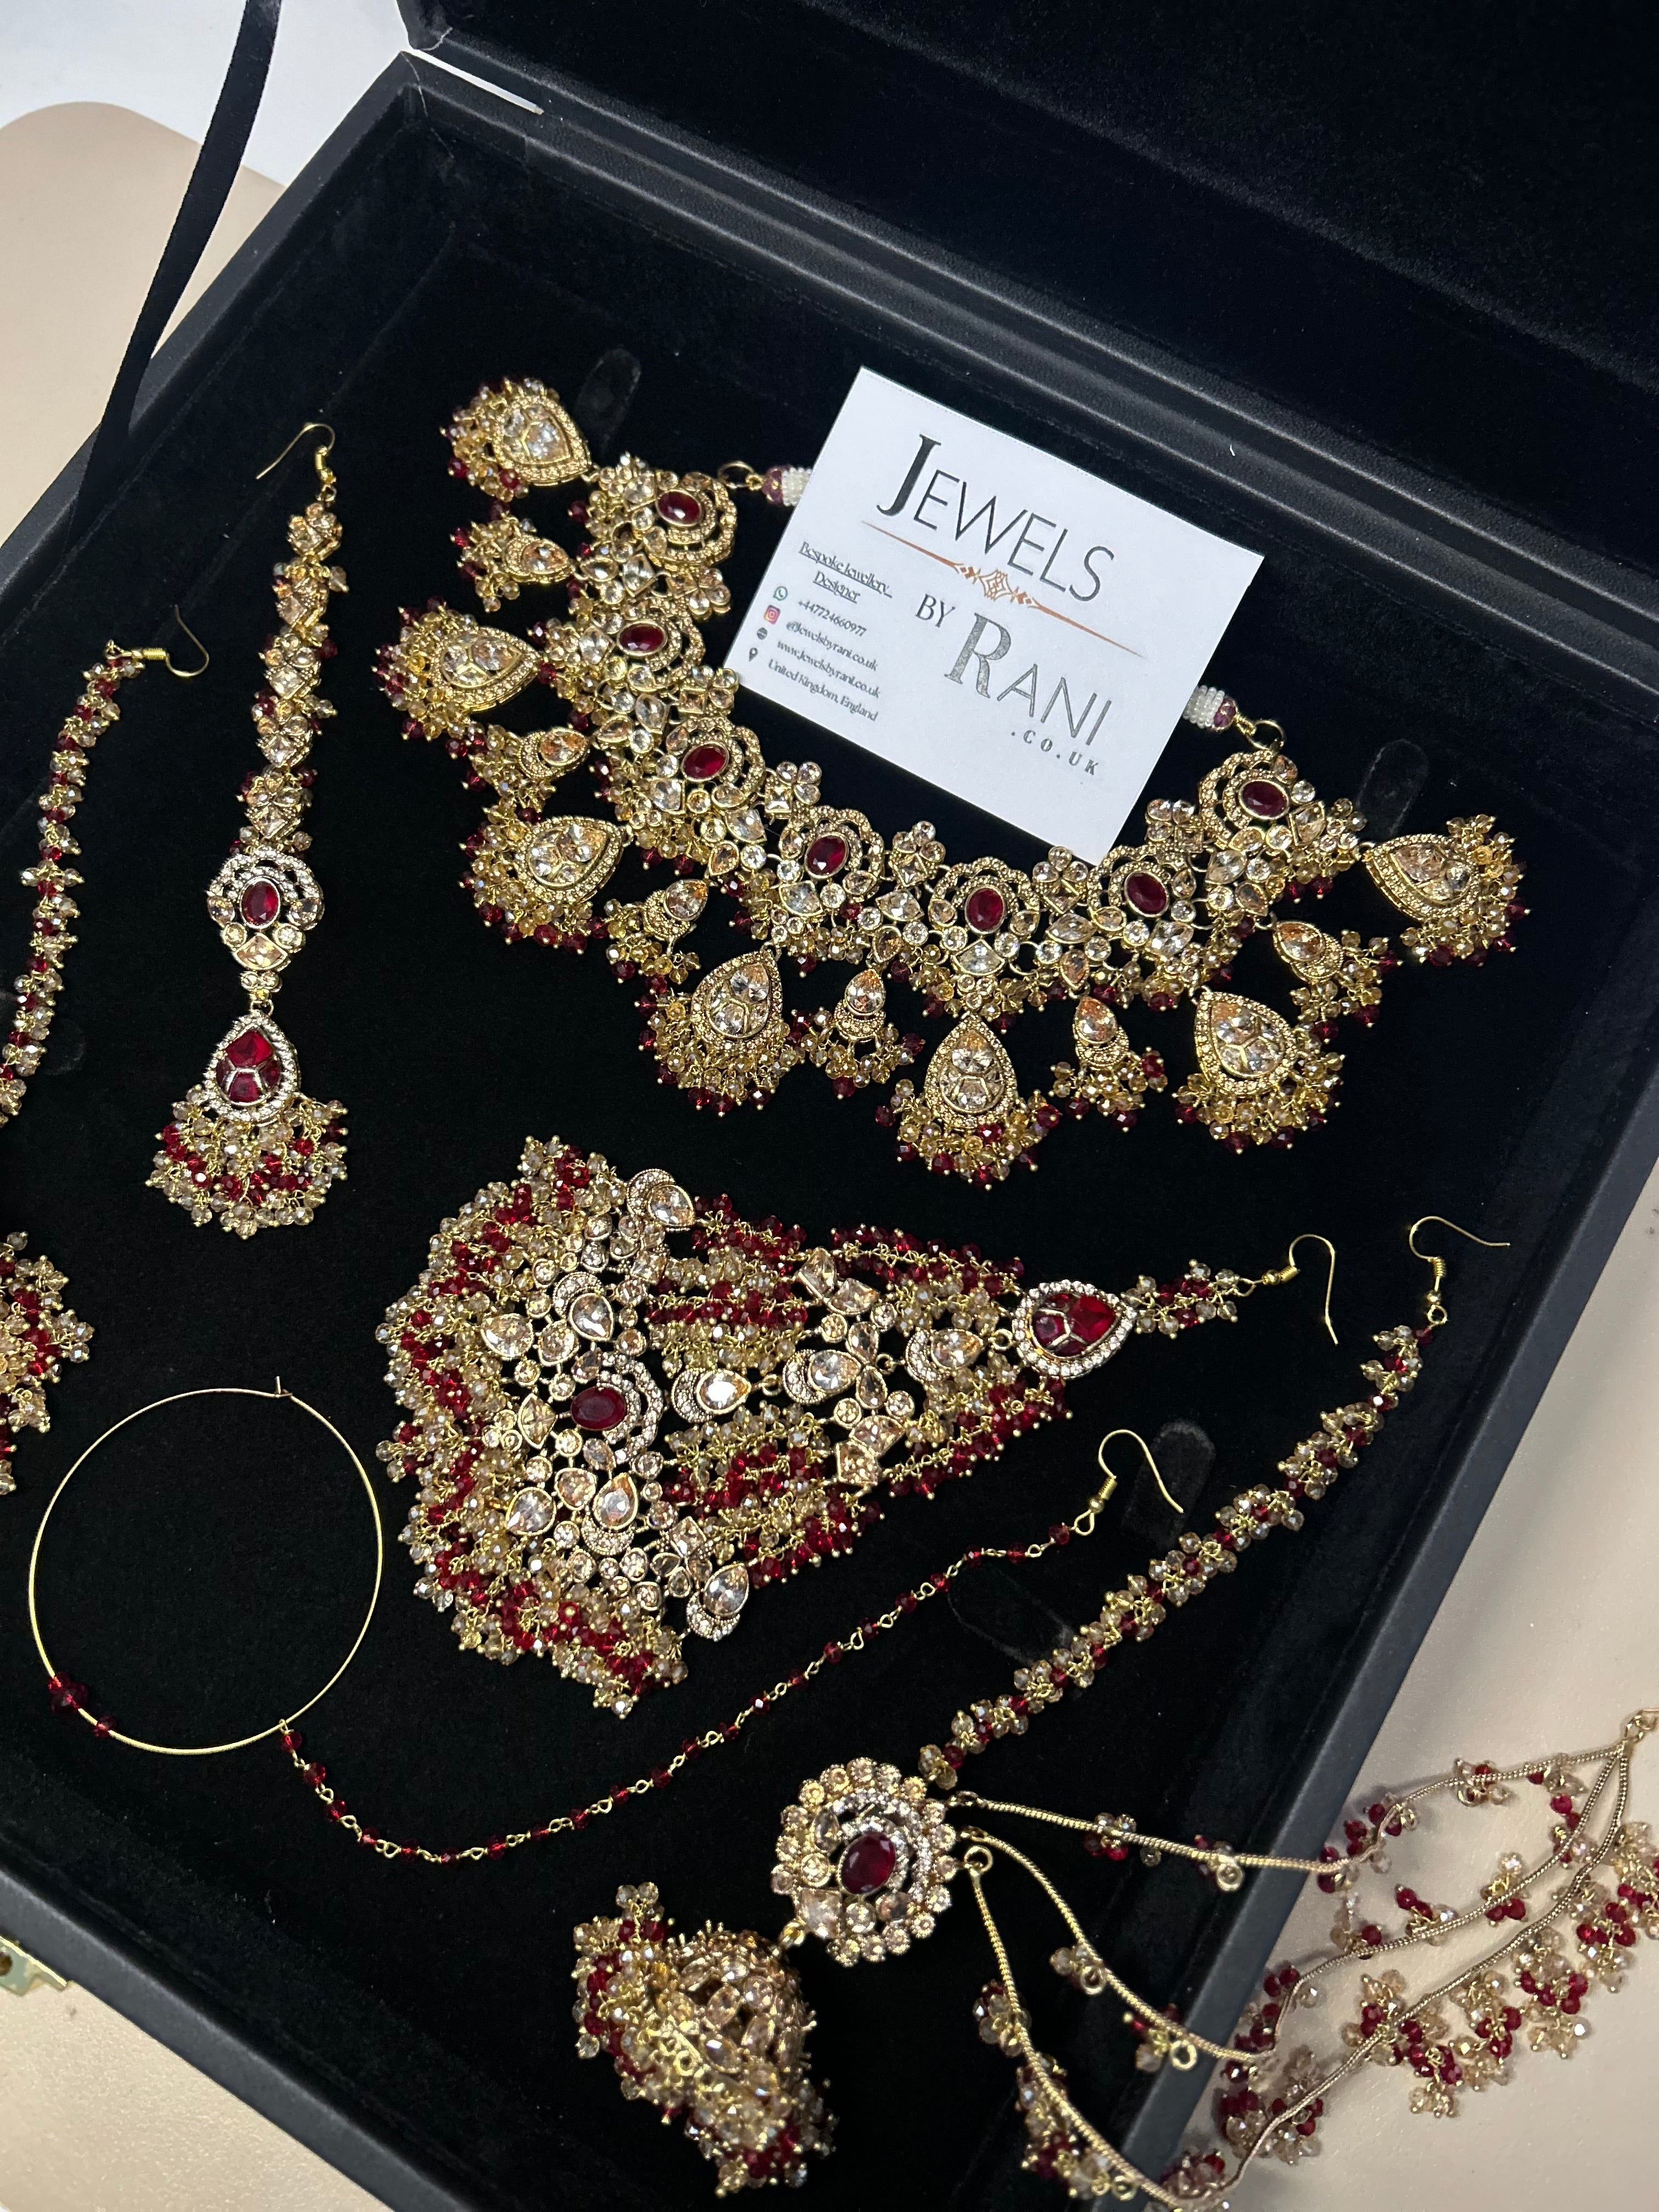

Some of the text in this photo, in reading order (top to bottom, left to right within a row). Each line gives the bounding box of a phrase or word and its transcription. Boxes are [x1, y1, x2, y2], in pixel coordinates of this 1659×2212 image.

[877, 434, 1114, 601] JEWELS
[799, 541, 890, 594] Bespoke Jewellery
[813, 571, 860, 603] Designer
[799, 601, 867, 636] +447724660977
[769, 659, 878, 721] United Kingdom, England
[915, 593, 1111, 745] BY RANI
